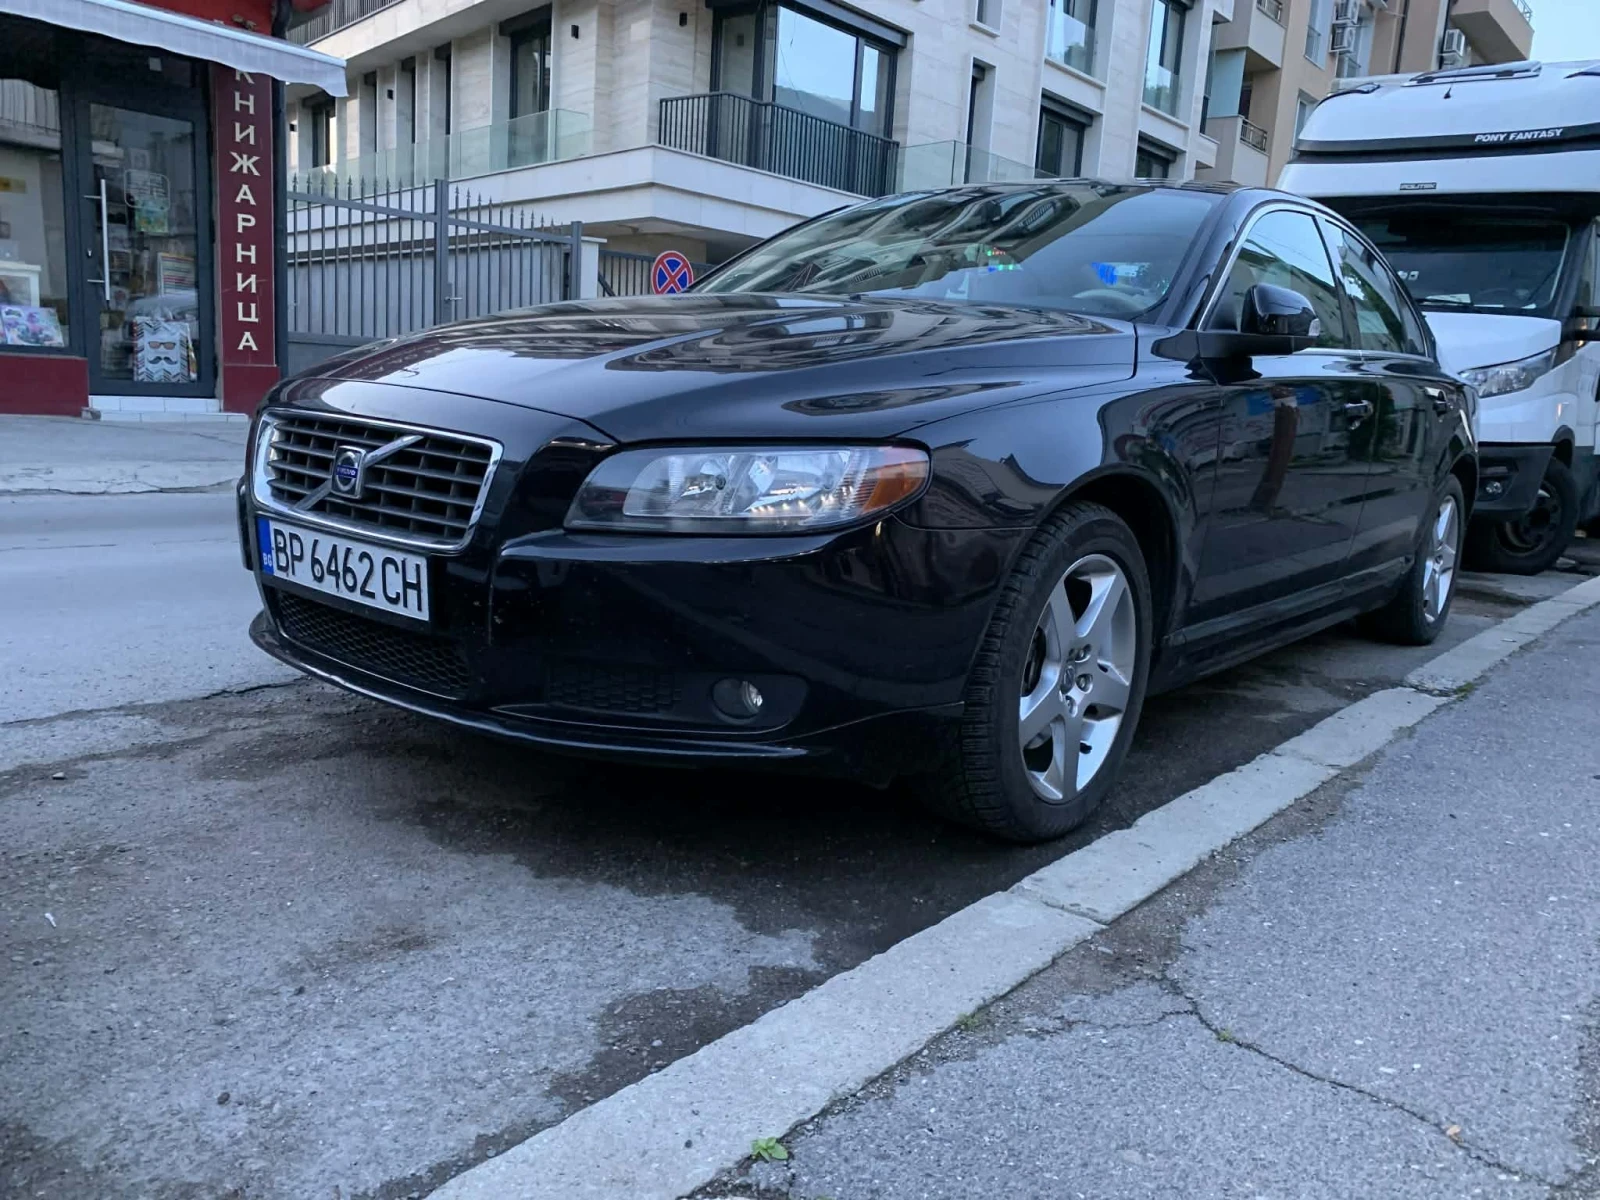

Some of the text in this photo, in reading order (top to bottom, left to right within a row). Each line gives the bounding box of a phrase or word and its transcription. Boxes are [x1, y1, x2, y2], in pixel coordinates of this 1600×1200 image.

[1474, 128, 1563, 142] PONY FANTASY
[262, 552, 273, 567] BG
[273, 528, 423, 612] BP 6462 CH
